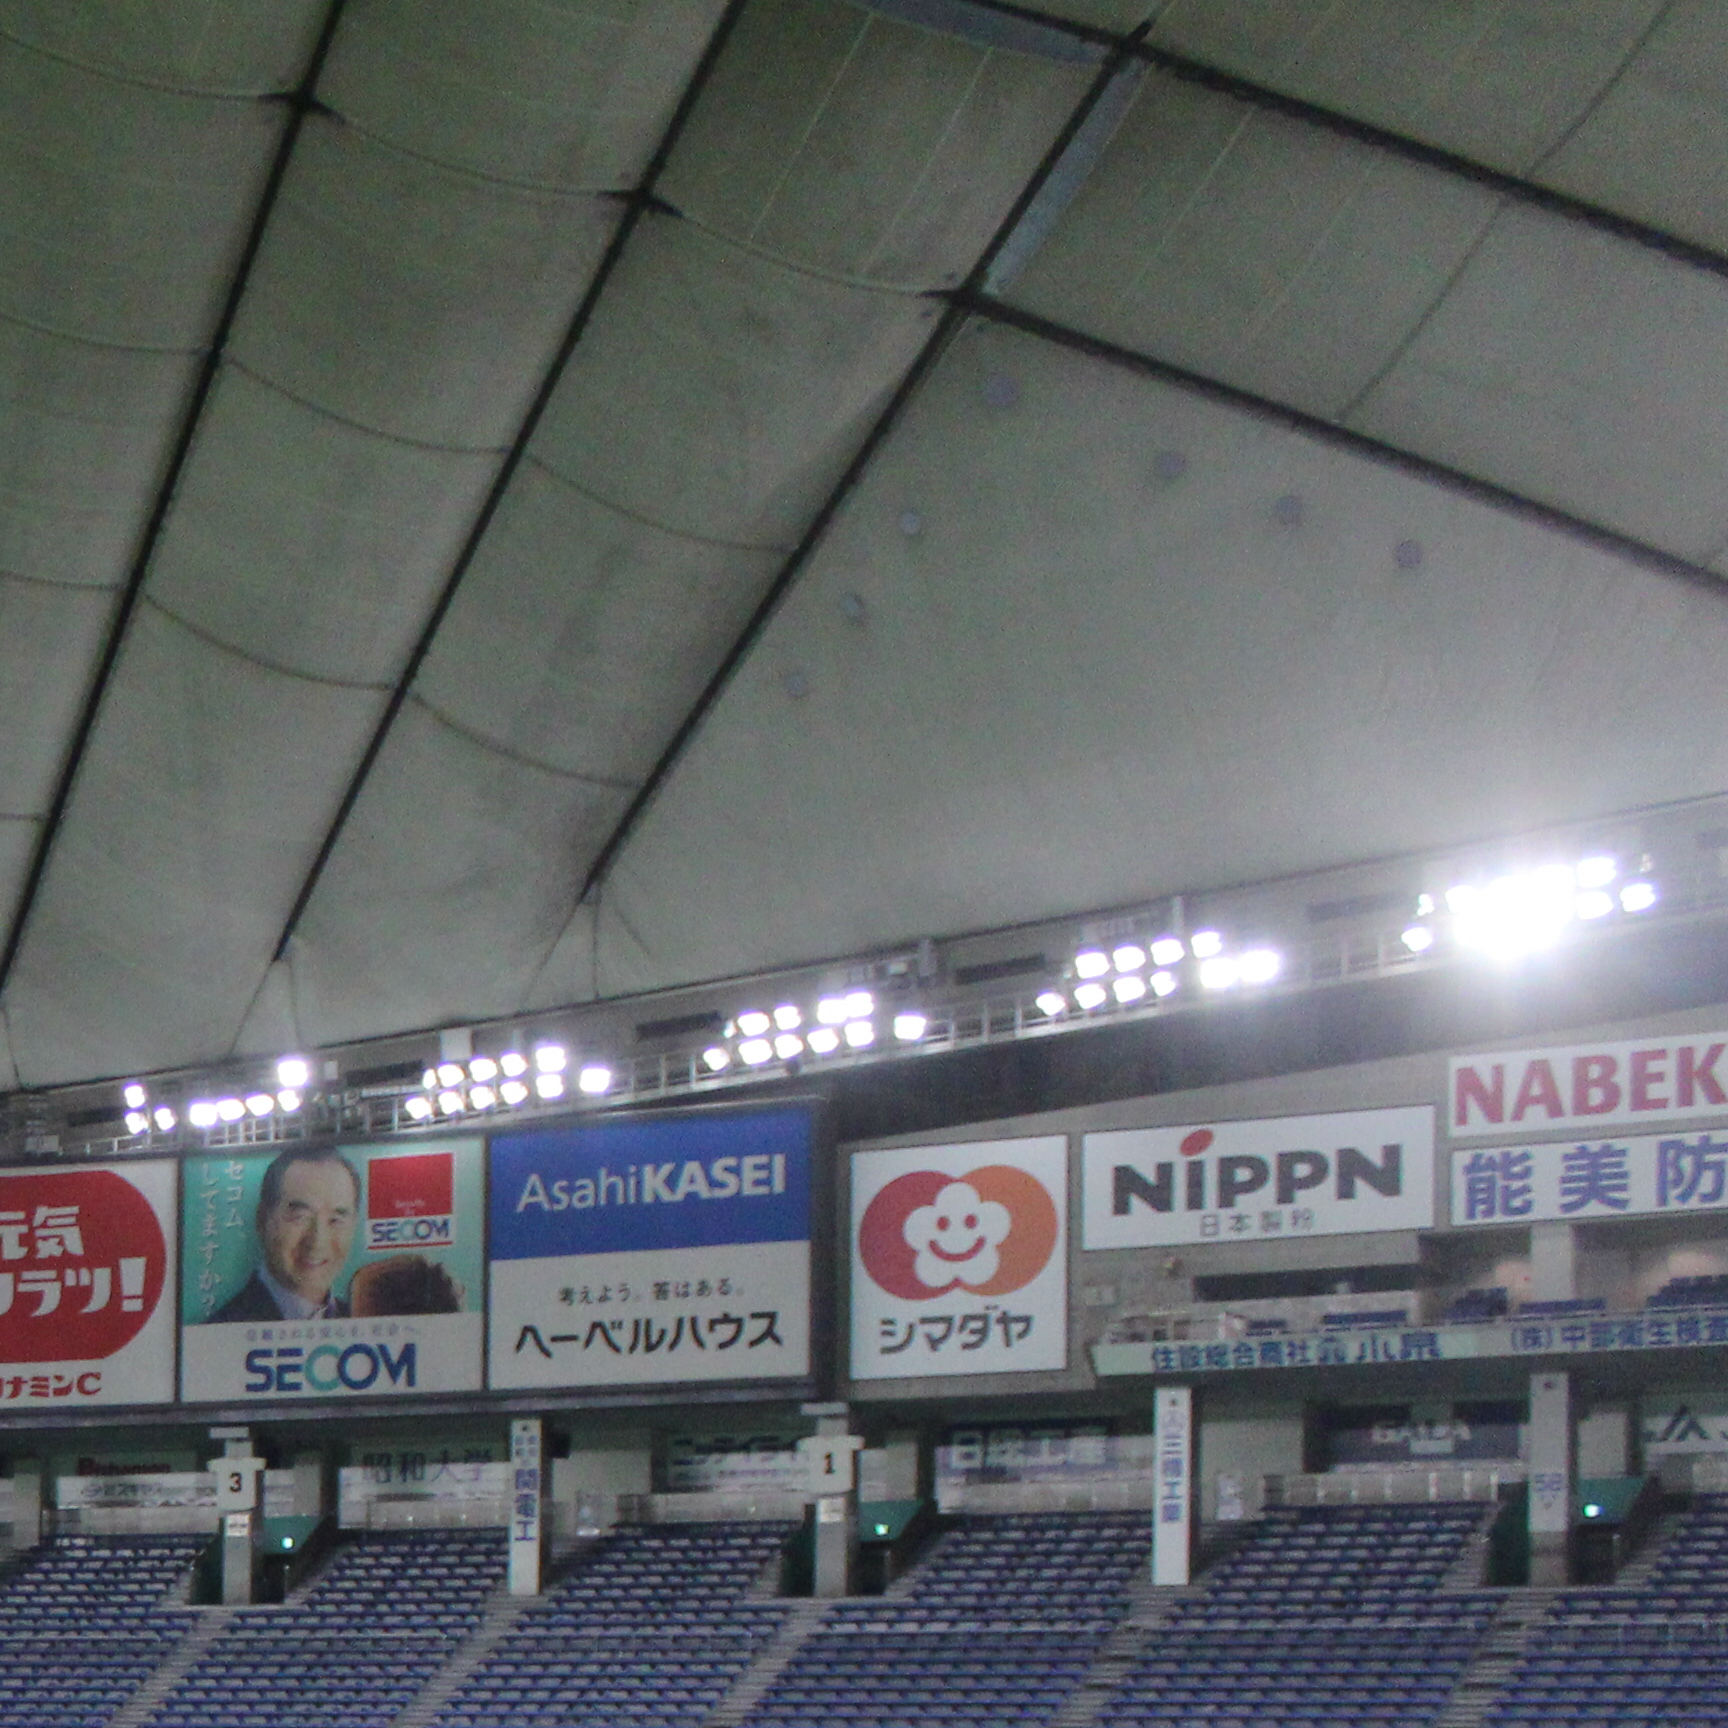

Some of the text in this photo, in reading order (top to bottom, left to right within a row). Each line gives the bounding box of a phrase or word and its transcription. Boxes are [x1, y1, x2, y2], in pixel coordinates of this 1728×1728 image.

[372, 1220, 451, 1243] SECOM
[1200, 1209, 1315, 1237] 日本製粉
[515, 1311, 783, 1358] ヘーベルハウス
[880, 1304, 1034, 1355] シマダヤ
[245, 1343, 417, 1392] SECOM
[824, 1452, 836, 1475] 1
[228, 1472, 242, 1493] 3
